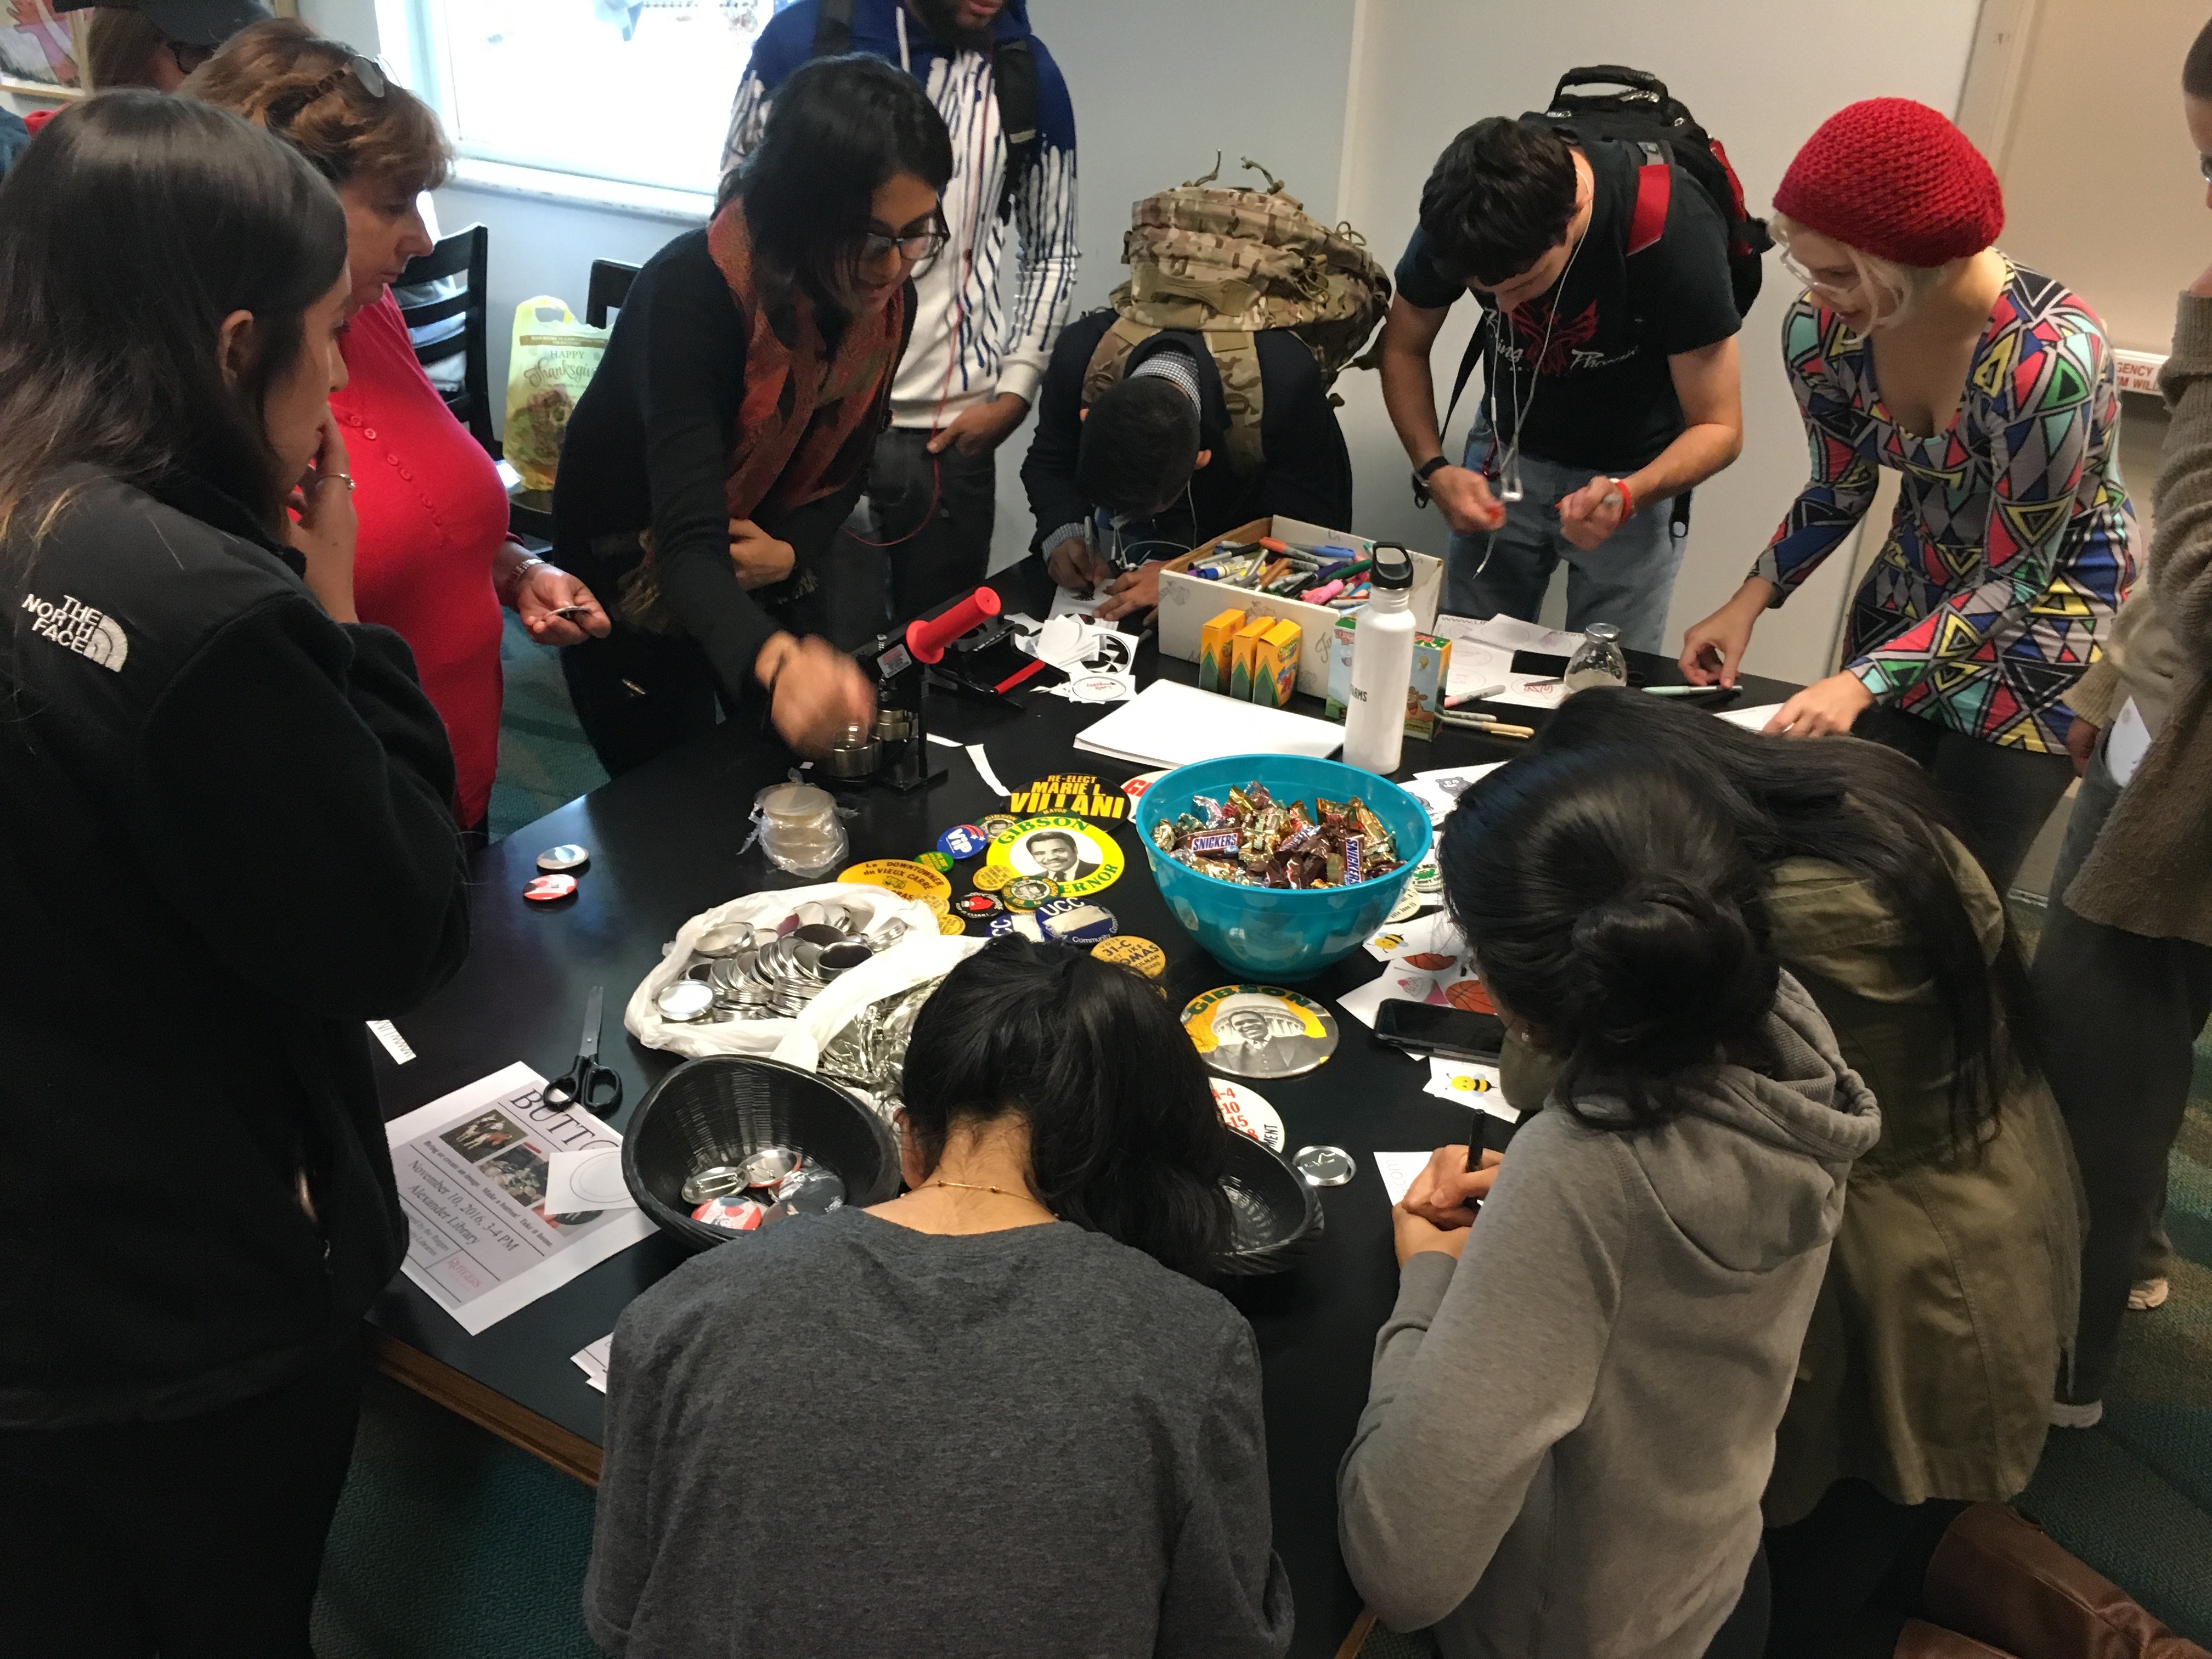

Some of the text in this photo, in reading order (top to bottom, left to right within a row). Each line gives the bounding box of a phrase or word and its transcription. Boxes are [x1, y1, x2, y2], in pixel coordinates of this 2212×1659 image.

[550, 351, 584, 359] HAPPY
[21, 594, 95, 642] NORTH
[64, 595, 103, 626] THE
[31, 617, 89, 654] FACE
[1031, 781, 1106, 797] MARIE L.
[1047, 775, 1097, 783] RE-ELECT
[1010, 792, 1125, 819] VILLANI
[998, 817, 1091, 845] GIBSON
[1192, 833, 1238, 851] SNICKERS
[877, 868, 905, 877] VIEUX
[887, 861, 944, 886] DOWNTOWNER
[1346, 839, 1360, 884] SNICKERS
[1059, 864, 1119, 894] ERNOR
[1039, 898, 1085, 916] UCC
[1072, 933, 1111, 944] Community
[1102, 939, 1132, 956] 31-C
[1189, 984, 1311, 1015] GIBSON
[1263, 1124, 1278, 1148] MENT
[408, 1159, 450, 1195] November
[447, 1193, 464, 1207] 10,
[482, 1222, 503, 1238] 3-4
[496, 1234, 519, 1252] PM
[408, 1184, 481, 1245] Alexander Library
[482, 1187, 497, 1201] Make
[518, 1218, 533, 1231] Take
